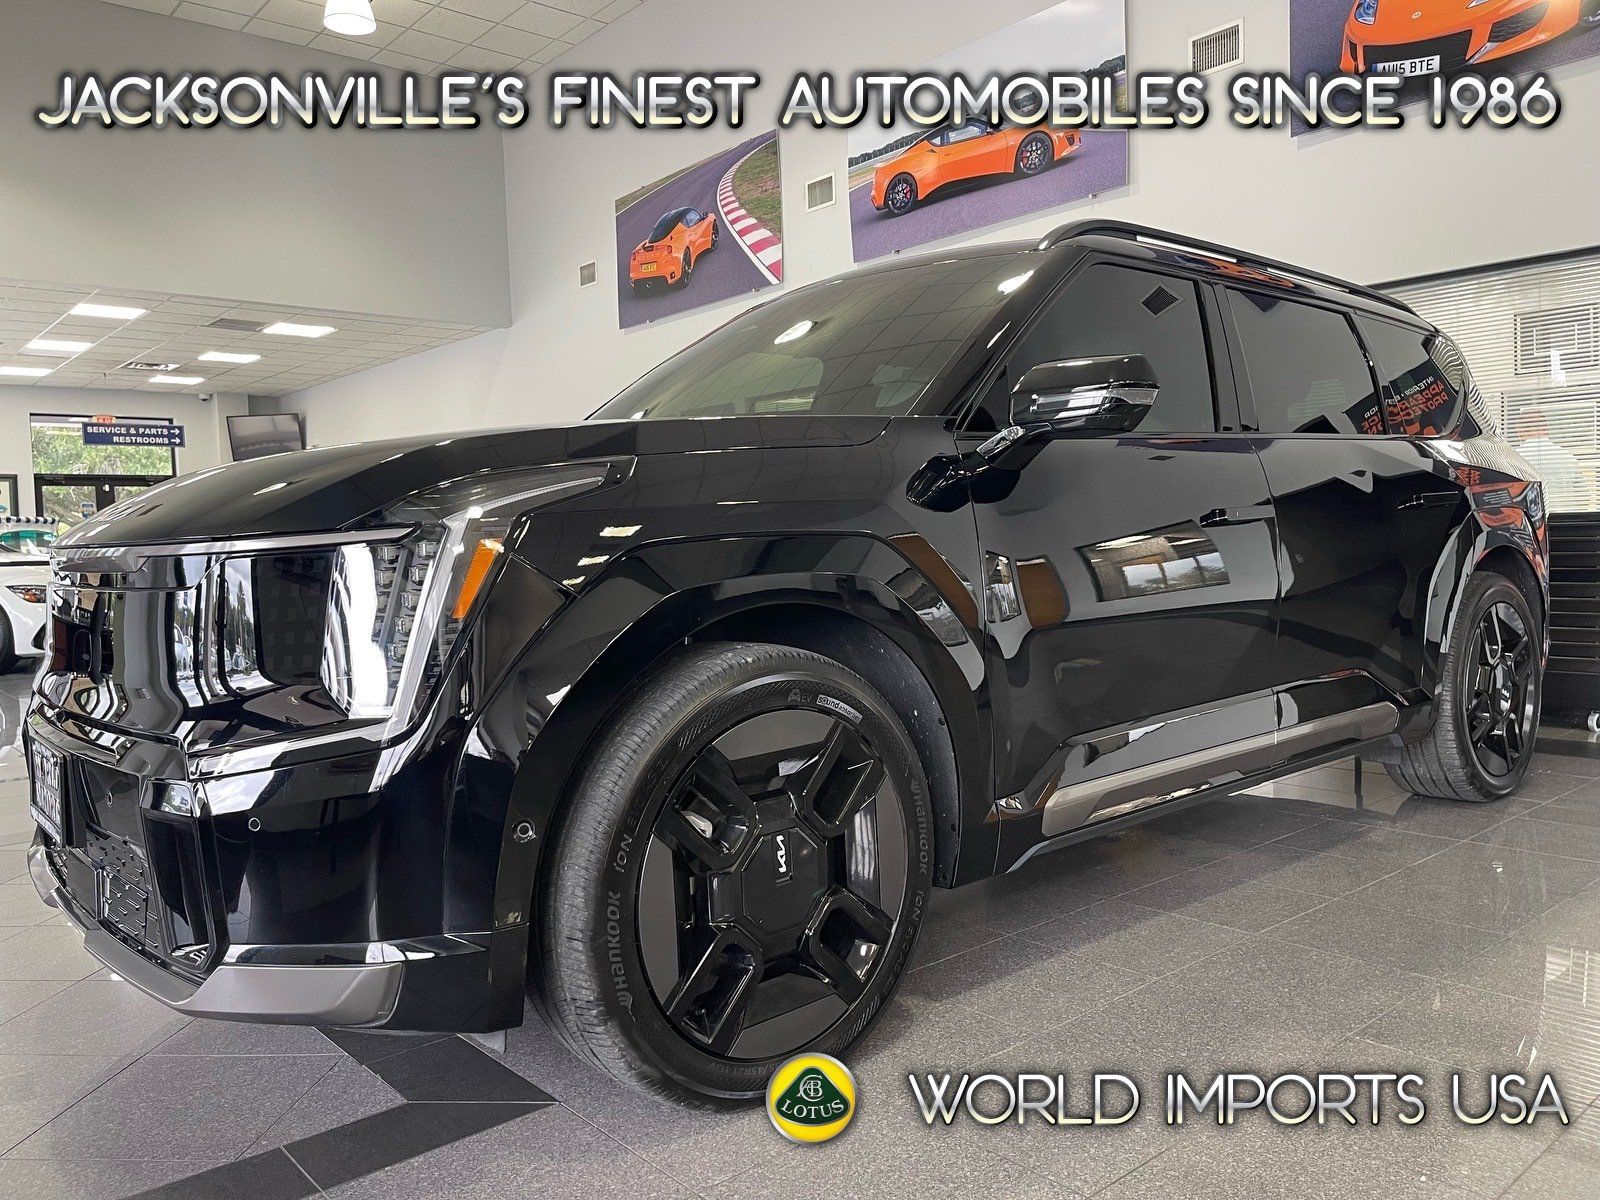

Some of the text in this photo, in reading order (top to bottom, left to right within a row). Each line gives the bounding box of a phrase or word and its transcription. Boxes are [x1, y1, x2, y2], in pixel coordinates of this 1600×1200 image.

[1409, 58, 1435, 74] BTE
[87, 426, 168, 435] SERVICE & PARTS
[113, 436, 169, 444] RESTROOMS
